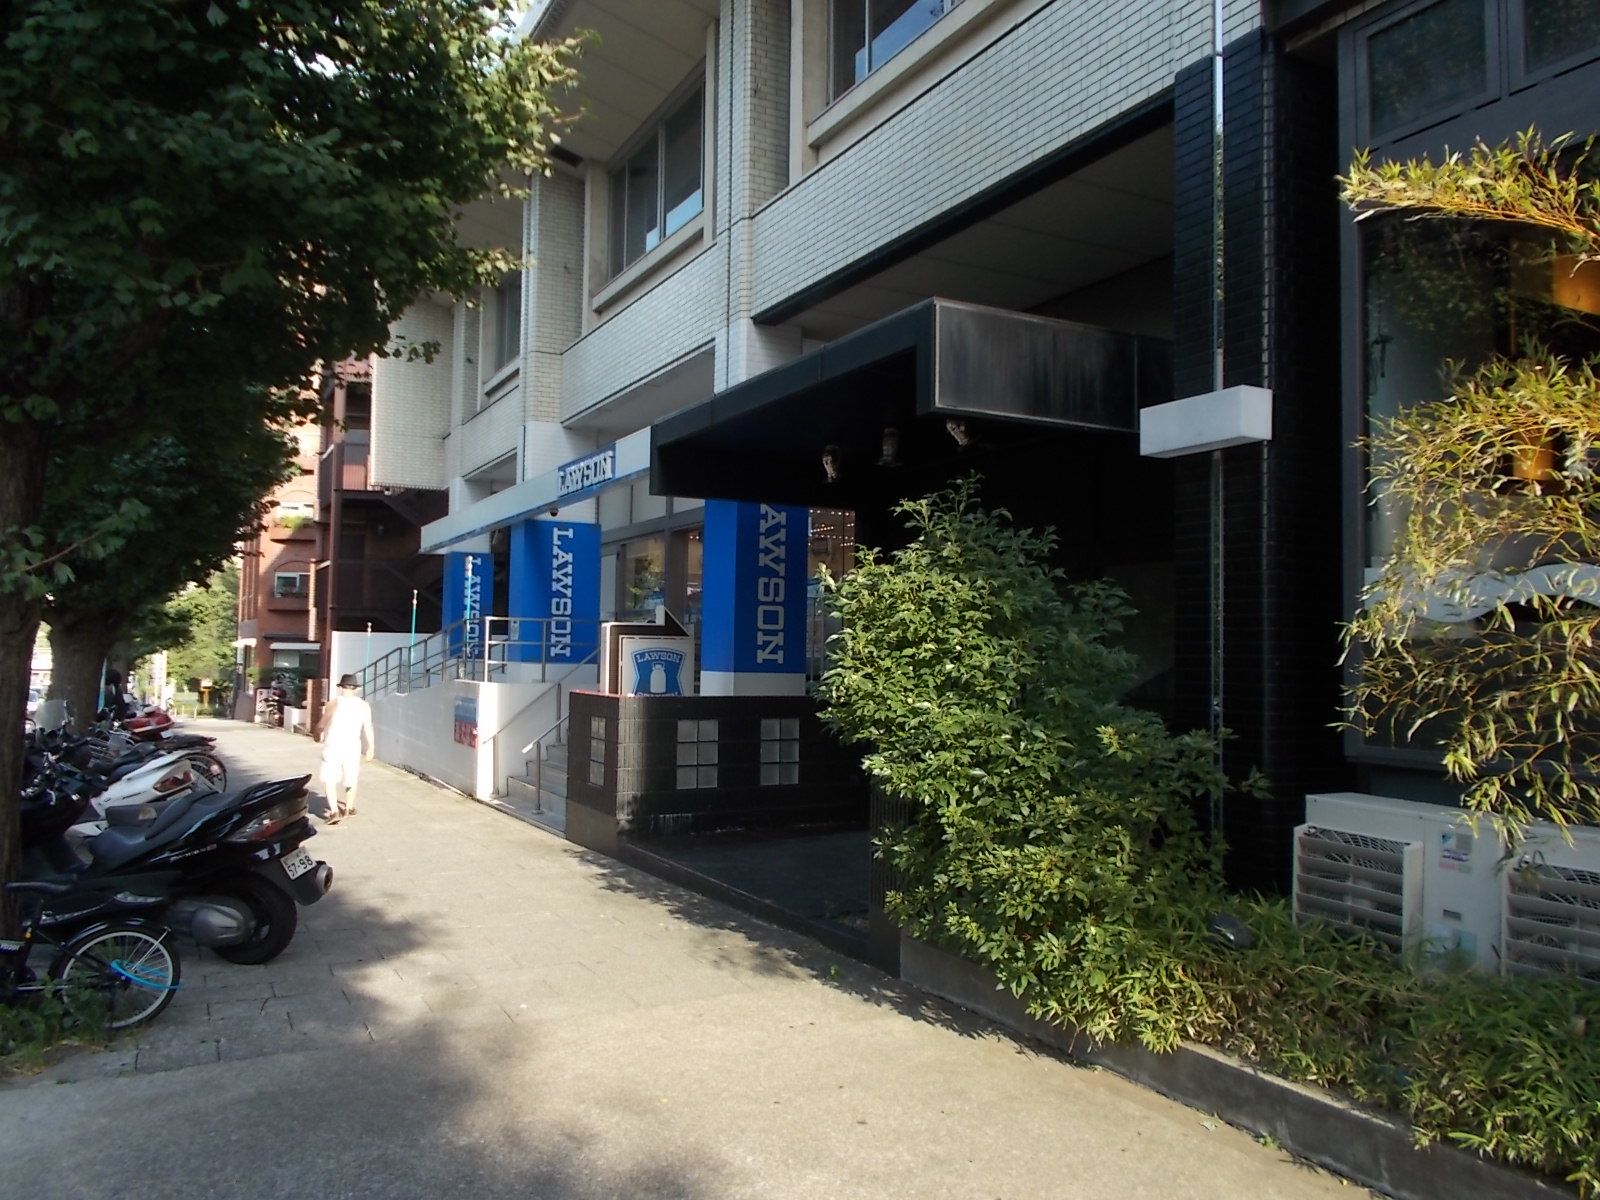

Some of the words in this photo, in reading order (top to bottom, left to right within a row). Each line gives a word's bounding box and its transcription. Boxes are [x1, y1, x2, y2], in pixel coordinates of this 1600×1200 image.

[558, 451, 613, 495] LAWSON
[551, 527, 574, 657] LAWSON
[756, 503, 786, 664] AWSON
[636, 652, 681, 663] LAWSON
